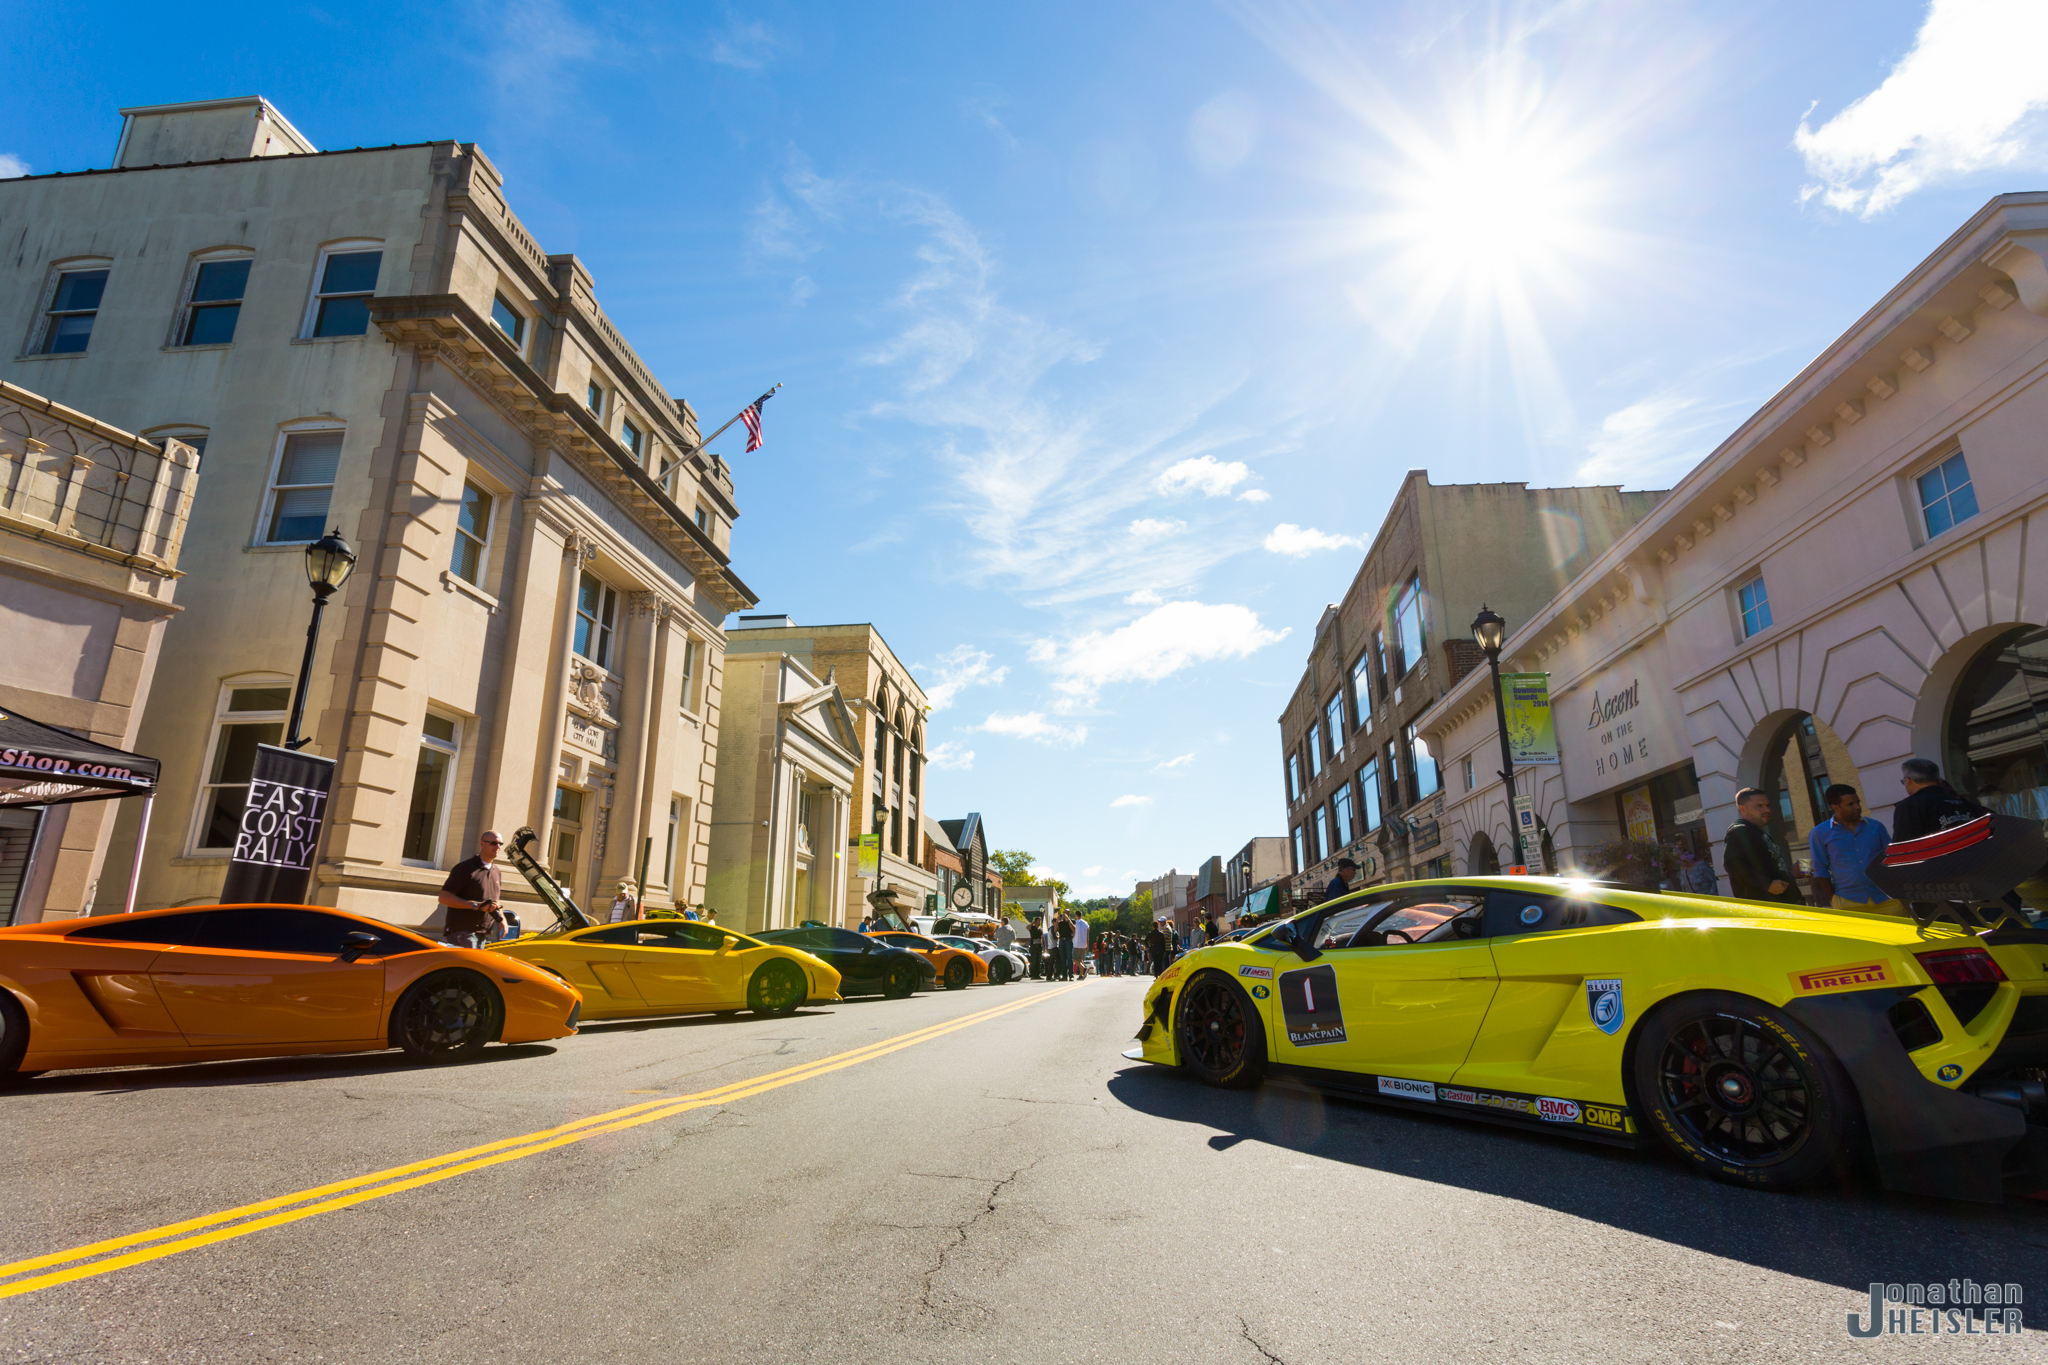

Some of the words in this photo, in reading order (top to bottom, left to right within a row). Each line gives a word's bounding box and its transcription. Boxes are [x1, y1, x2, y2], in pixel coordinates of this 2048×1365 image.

[1587, 678, 1639, 730] Accent
[572, 732, 585, 743] CITY
[1601, 731, 1613, 745] ON
[1615, 720, 1633, 738] THE
[0, 748, 131, 782] Shop.com
[1595, 737, 1648, 776] HOME
[246, 781, 326, 818] EAST
[241, 808, 321, 842] COAST
[233, 832, 315, 867] RALLY
[1799, 965, 1886, 990] PIRELLI
[1303, 976, 1315, 1012] 1
[1290, 1026, 1344, 1042] BLANCPAIN
[1755, 1015, 1813, 1066] PIRELL
[1447, 1090, 1474, 1103] Castrol
[1477, 1093, 1531, 1113] EDGE
[1540, 1099, 1575, 1117] BMC
[1542, 1112, 1557, 1121] Air
[1585, 1107, 1621, 1126] OMP
